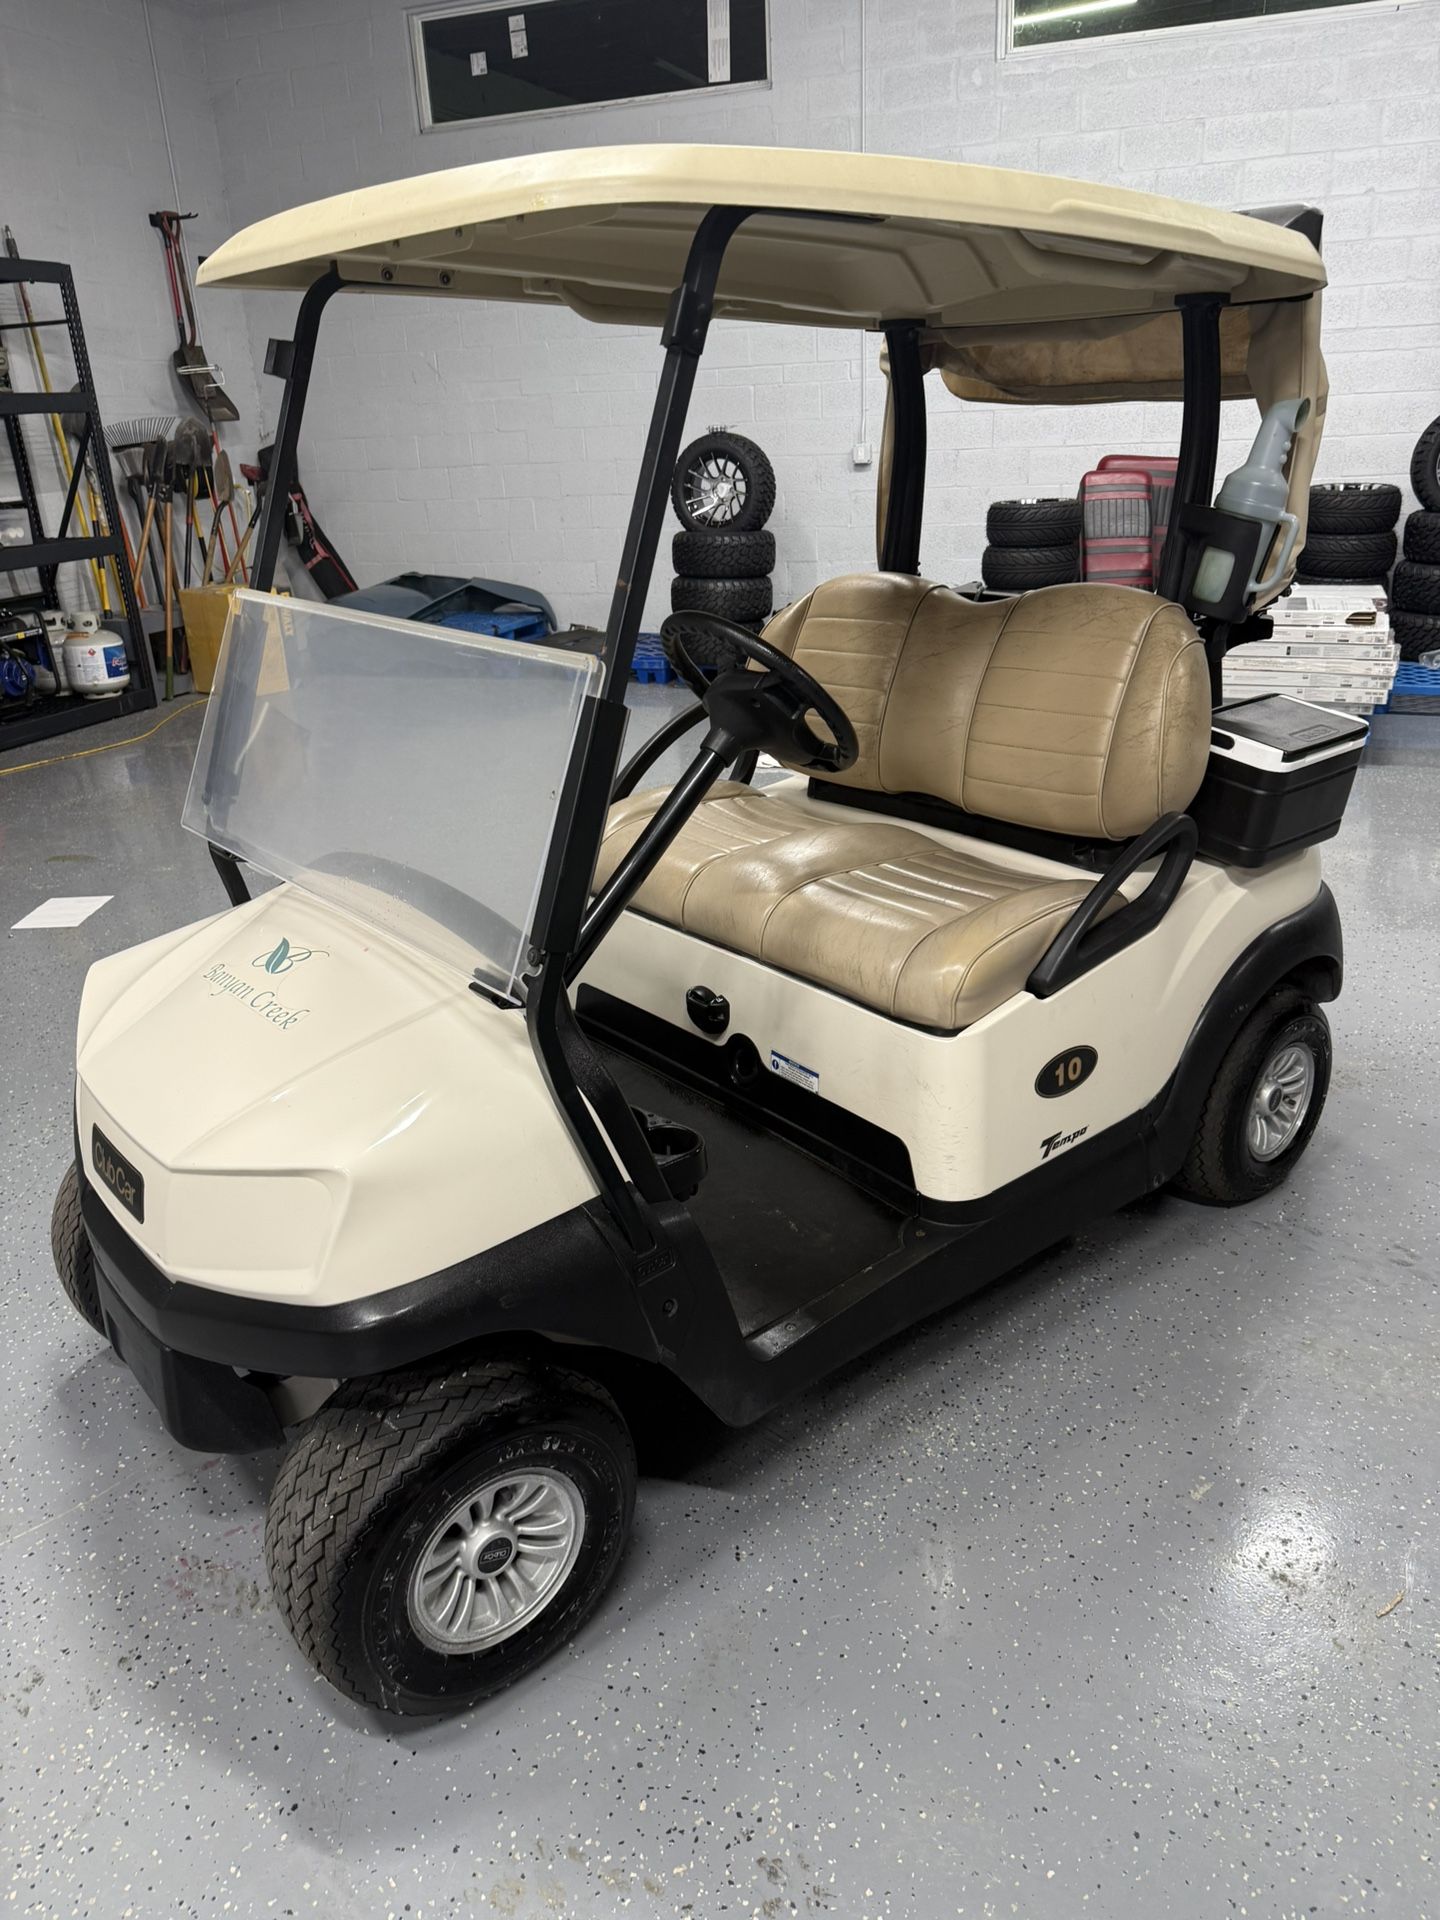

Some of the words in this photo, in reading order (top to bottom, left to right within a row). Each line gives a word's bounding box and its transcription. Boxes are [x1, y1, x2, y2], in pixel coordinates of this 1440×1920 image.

[203, 963, 254, 999] Banyan
[250, 991, 311, 1030] Creek
[1055, 1056, 1082, 1088] 10
[1040, 1126, 1088, 1160] Tempo
